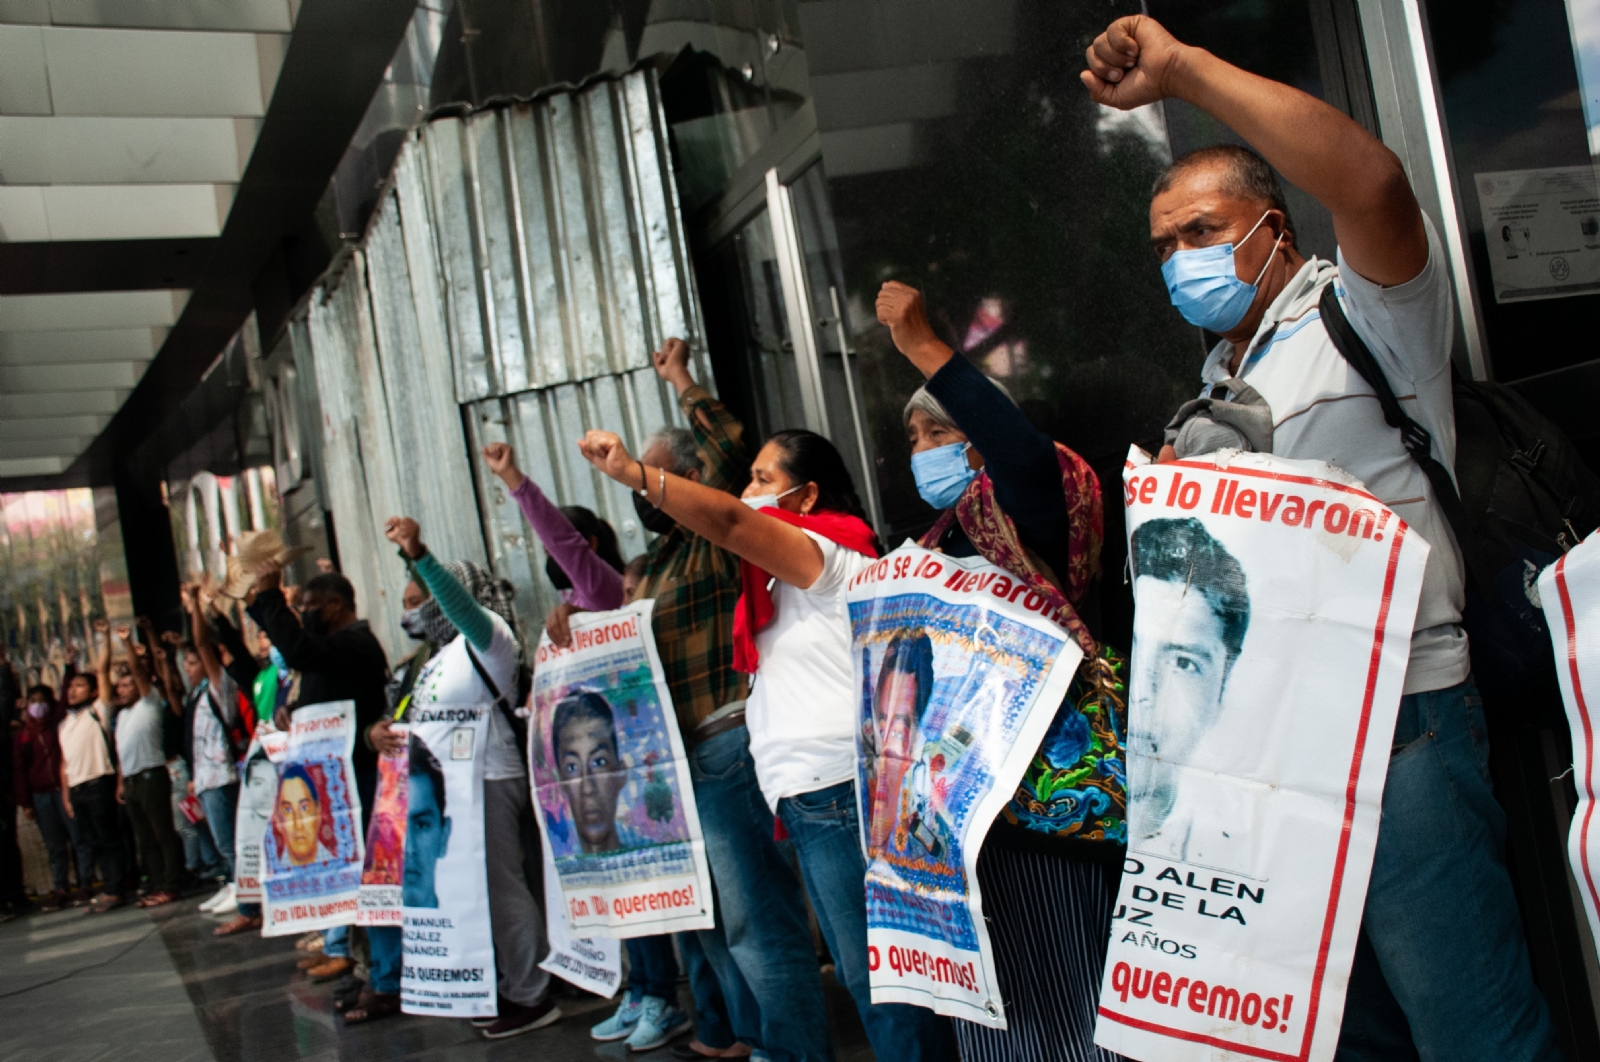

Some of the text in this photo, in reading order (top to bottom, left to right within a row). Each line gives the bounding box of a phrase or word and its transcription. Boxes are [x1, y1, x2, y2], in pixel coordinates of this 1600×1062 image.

[1128, 472, 1392, 543] se lo llevaron!
[893, 555, 912, 579] se
[912, 554, 944, 579] lo
[574, 616, 638, 650] llevaron!
[613, 884, 696, 920] queremos!
[1155, 866, 1265, 904] ALEN
[412, 917, 454, 928] MANUEL
[1131, 885, 1247, 925] DE LA
[1121, 930, 1197, 959] AÑOS
[417, 967, 484, 982] QUEREMOS!
[888, 945, 979, 993] queremos!
[1111, 961, 1294, 1034] queremos!
